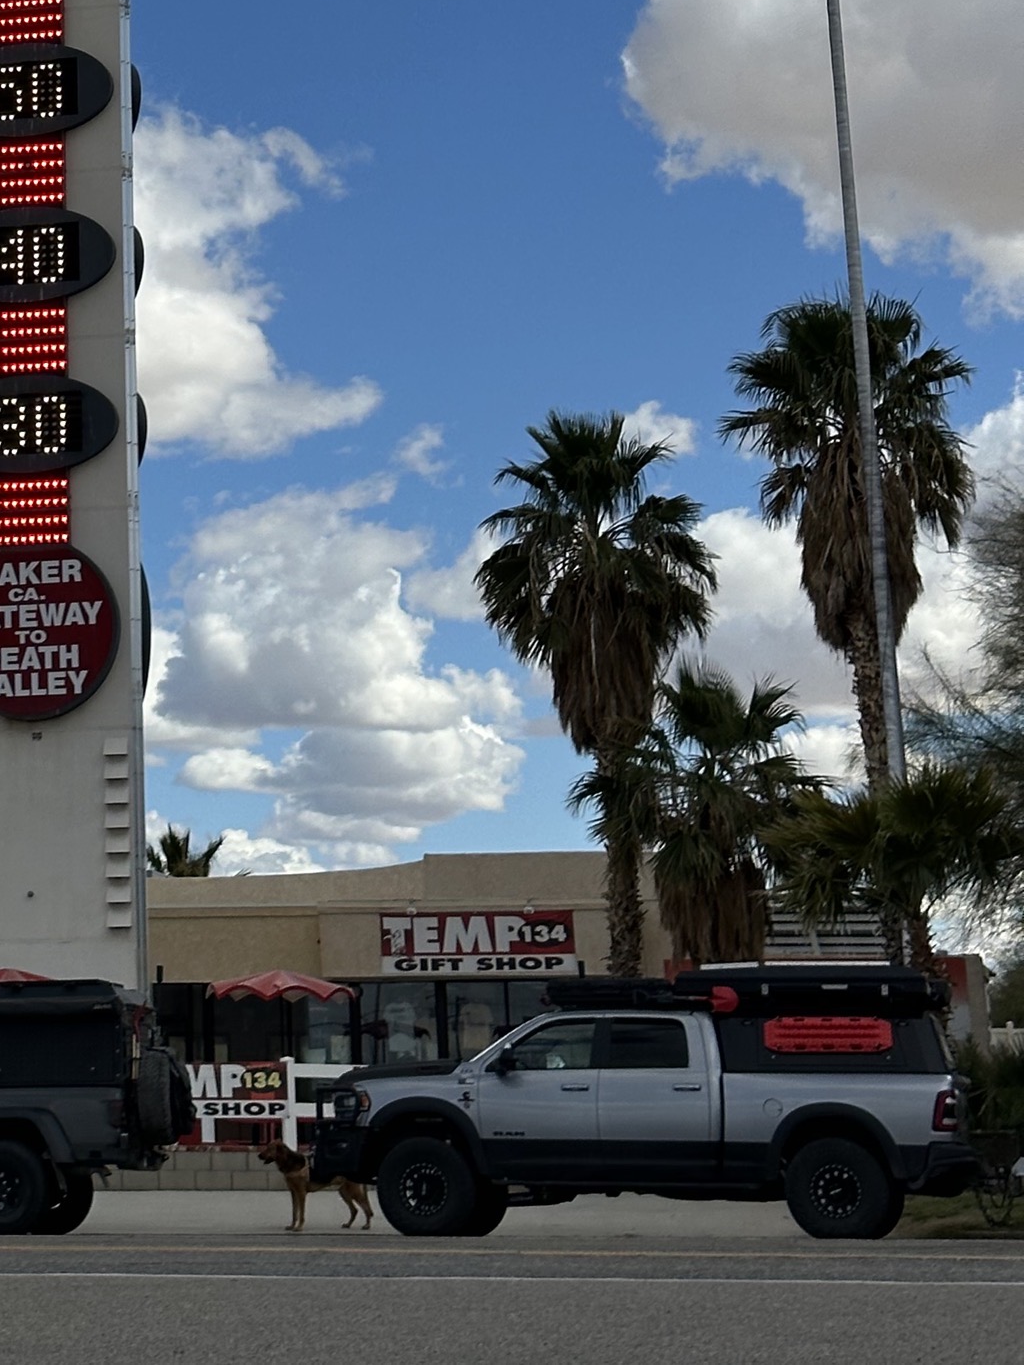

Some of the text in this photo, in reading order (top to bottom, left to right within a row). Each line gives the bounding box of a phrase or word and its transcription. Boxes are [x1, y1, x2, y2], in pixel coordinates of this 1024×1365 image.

[8, 587, 46, 602] CA.
[14, 630, 48, 644] TO
[382, 916, 567, 954] TEMP 134
[394, 956, 564, 972] GIFT SHOP
[243, 1071, 282, 1088] 134
[203, 1102, 286, 1116] SHOP
